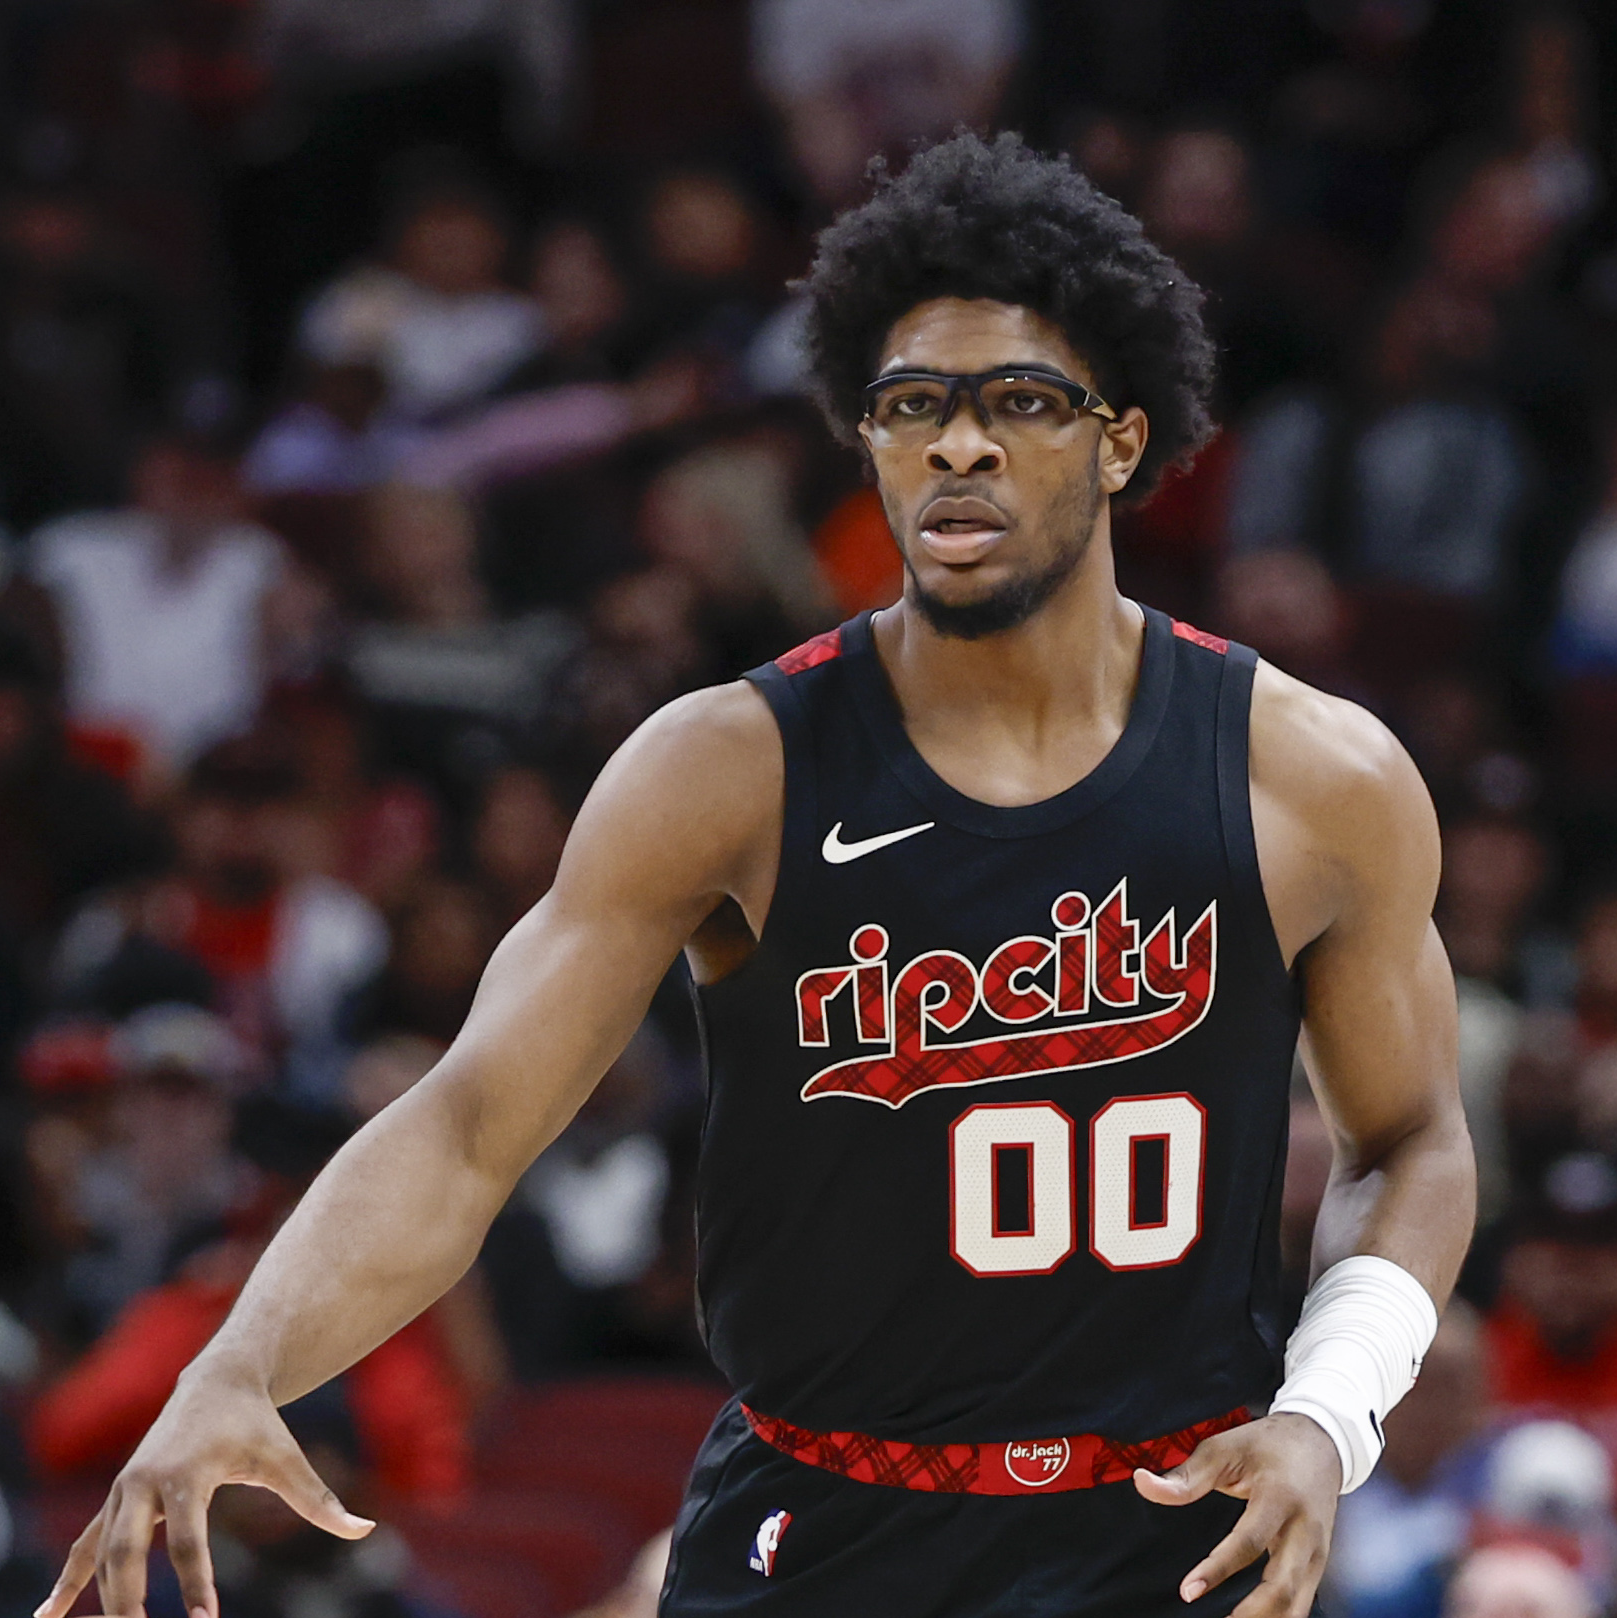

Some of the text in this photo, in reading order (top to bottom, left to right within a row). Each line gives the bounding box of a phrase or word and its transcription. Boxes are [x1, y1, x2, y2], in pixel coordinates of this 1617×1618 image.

[795, 877, 1217, 1109] ripcity
[949, 1092, 1206, 1277] 00
[1042, 1457, 1061, 1471] 77
